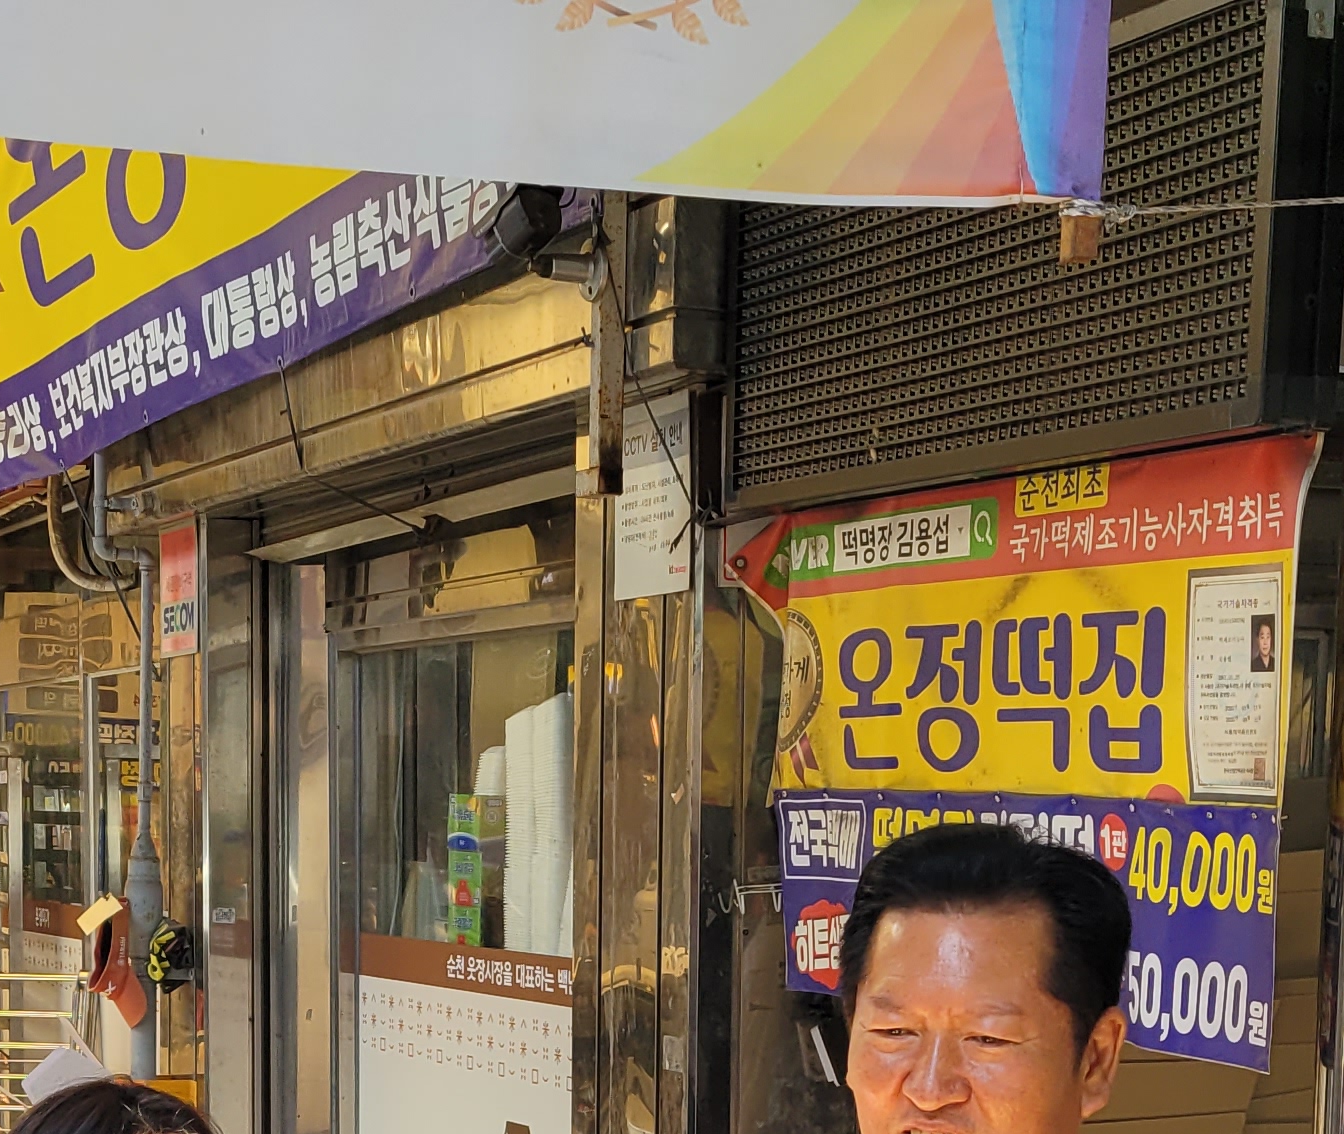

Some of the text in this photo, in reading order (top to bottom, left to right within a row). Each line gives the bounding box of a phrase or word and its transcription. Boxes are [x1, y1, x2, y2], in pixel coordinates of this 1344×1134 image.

[47, 307, 201, 439] 보건복지부장관상,
[201, 252, 308, 361] 대통령상,
[623, 433, 648, 457] CCTV
[669, 421, 684, 447] 안내
[1018, 463, 1105, 512] 순천최초
[842, 522, 892, 565] 떡명장
[896, 513, 950, 559] 김용섭
[1009, 492, 1284, 563] 국가떡제조기능사자격취득
[163, 601, 195, 635] SECOM
[837, 606, 1165, 774] 온정떡집
[788, 809, 861, 870] 전국택배
[1100, 823, 1128, 860] 1판
[446, 954, 465, 980] 순천
[467, 956, 513, 987] 웃장시장을
[515, 963, 555, 993] 대표하는
